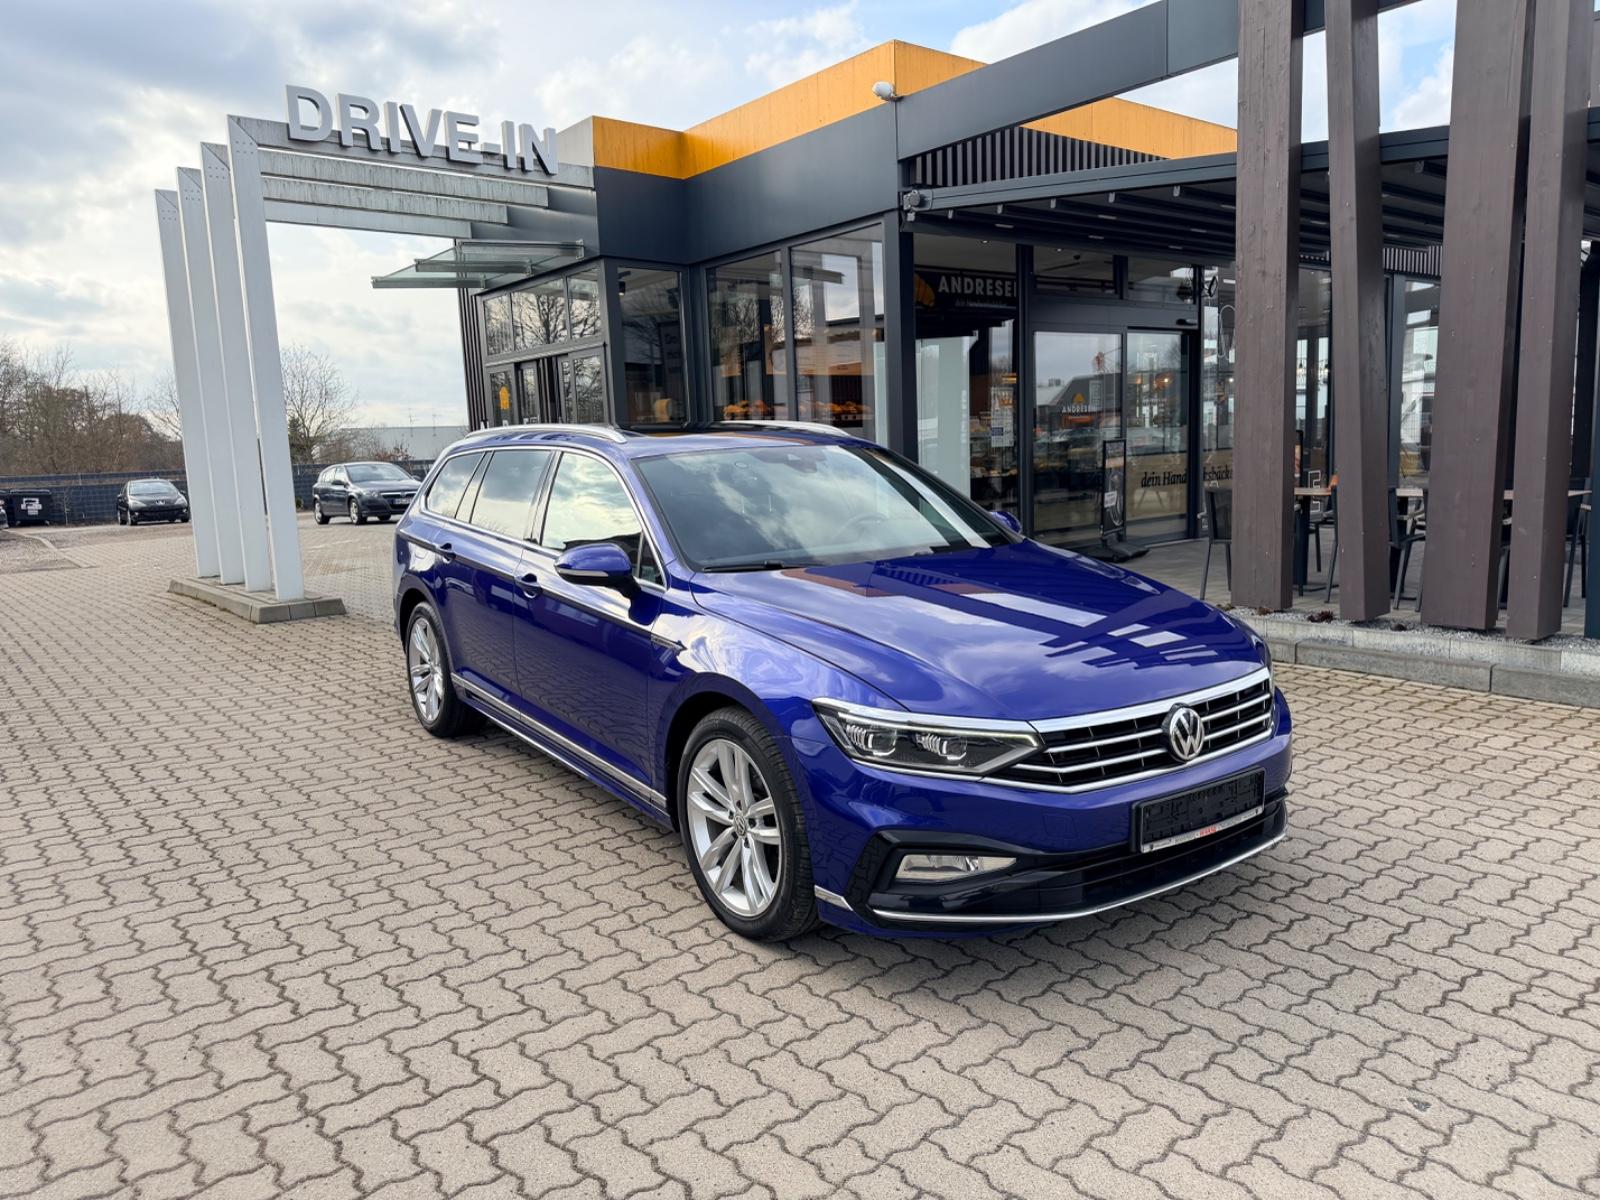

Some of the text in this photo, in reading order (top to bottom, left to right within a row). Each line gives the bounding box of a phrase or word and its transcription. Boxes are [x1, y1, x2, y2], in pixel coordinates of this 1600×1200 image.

[285, 84, 559, 177] DRIVE-IN
[938, 275, 1017, 298] ANDRESE
[1141, 471, 1161, 488] dein
